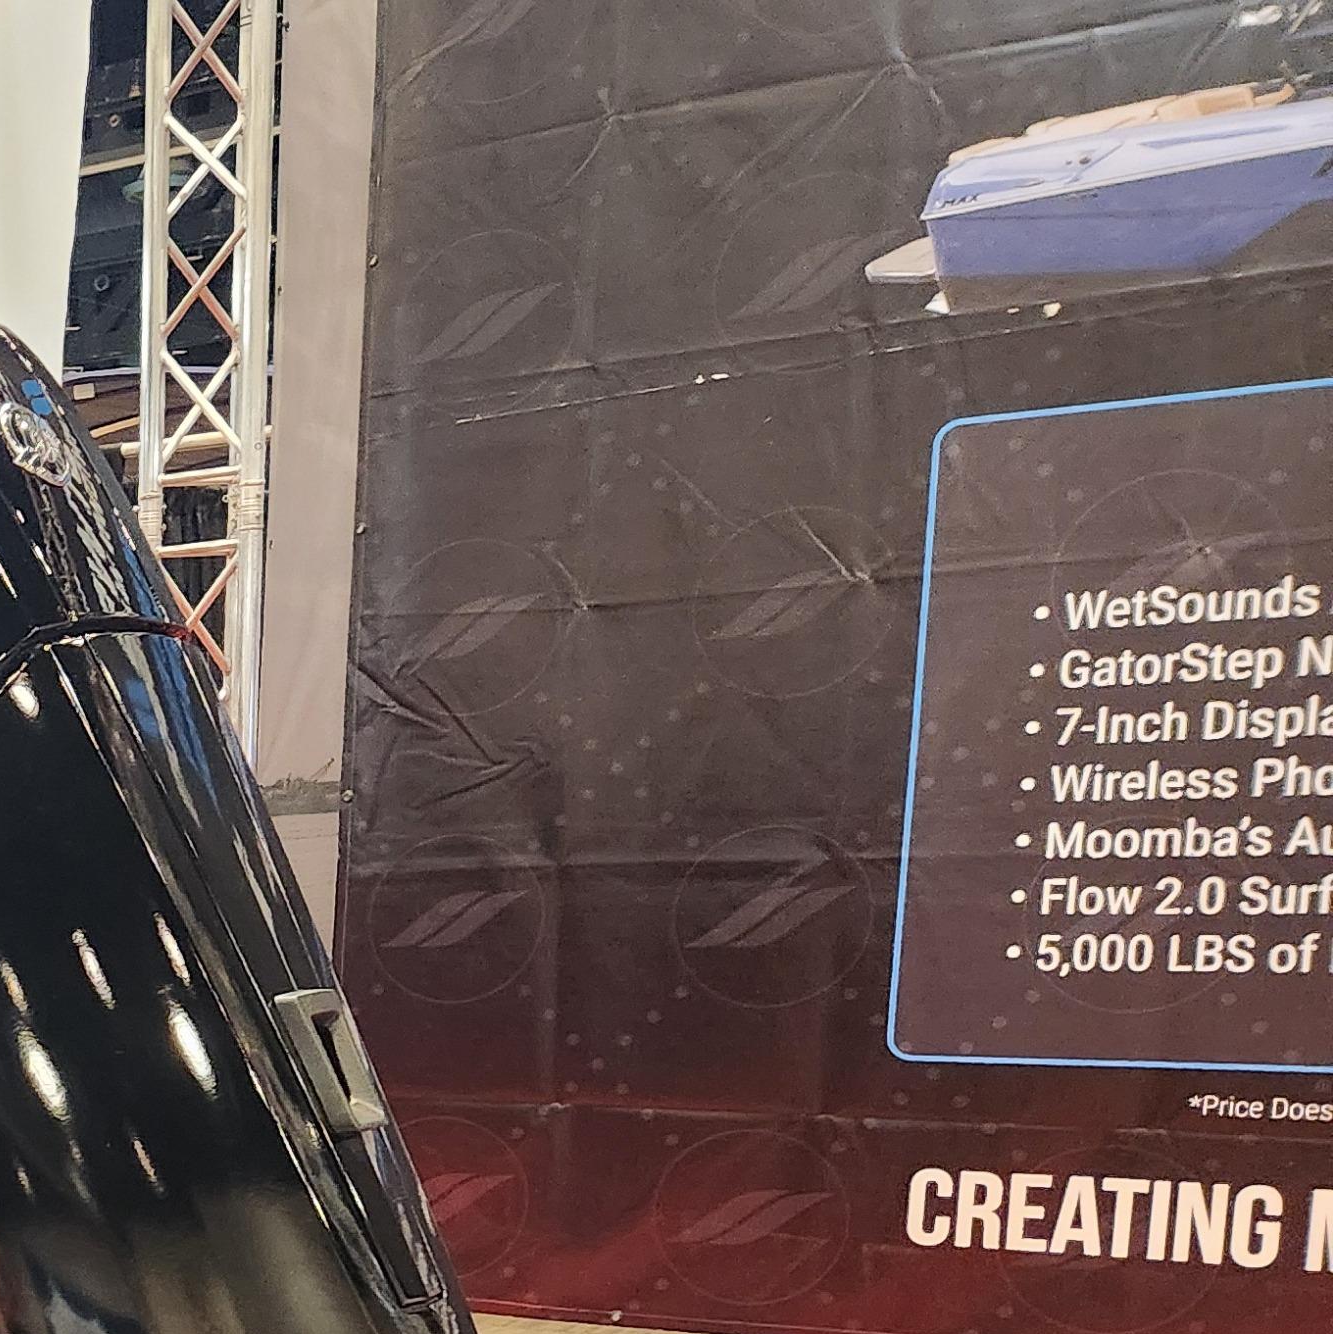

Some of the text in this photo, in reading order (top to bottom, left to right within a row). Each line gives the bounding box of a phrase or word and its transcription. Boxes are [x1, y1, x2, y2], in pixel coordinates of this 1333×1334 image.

[1064, 574, 1321, 631] WetSounds
[1059, 641, 1284, 689] GatorStep
[1055, 701, 1189, 747] 7-Inch
[1050, 760, 1238, 803] Wireless
[1045, 815, 1274, 859] Moomba's
[1039, 875, 1143, 916] Flow
[1154, 875, 1226, 916] 2.0
[1035, 932, 1322, 978] 5,000 LBS of
[1271, 1096, 1333, 1122] Does
[906, 1167, 1283, 1269] CREATING
